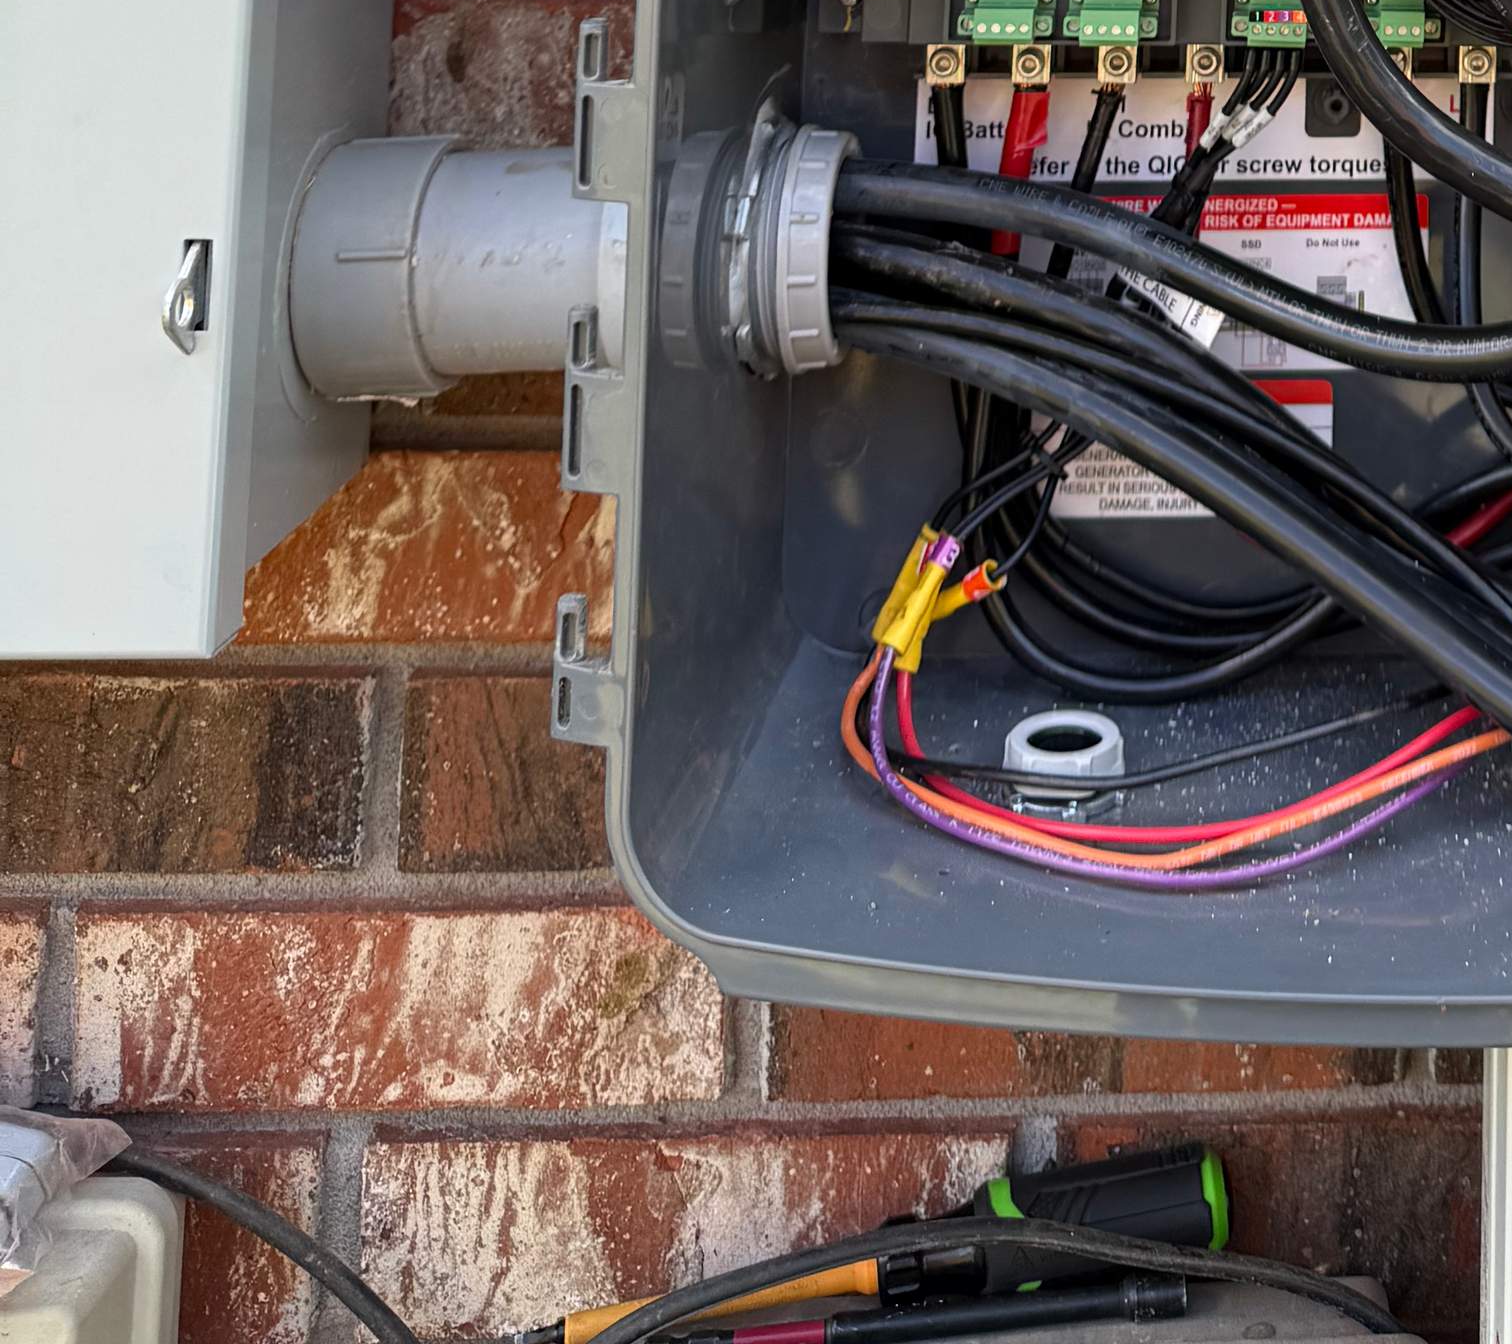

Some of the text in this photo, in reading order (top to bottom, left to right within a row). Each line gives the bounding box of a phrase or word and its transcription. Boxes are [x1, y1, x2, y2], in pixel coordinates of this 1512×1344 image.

[1105, 155, 1302, 176] the screw
[1204, 198, 1279, 212] NERGIZED
[1204, 213, 1351, 228] RISK OF EQUIPMENT
[1305, 238, 1361, 249] Do Not Use
[1143, 277, 1178, 311] CABLE
[1059, 481, 1176, 494] RESULT IN SERIOUS
[1099, 498, 1198, 511] DAMAGE, INJURY
